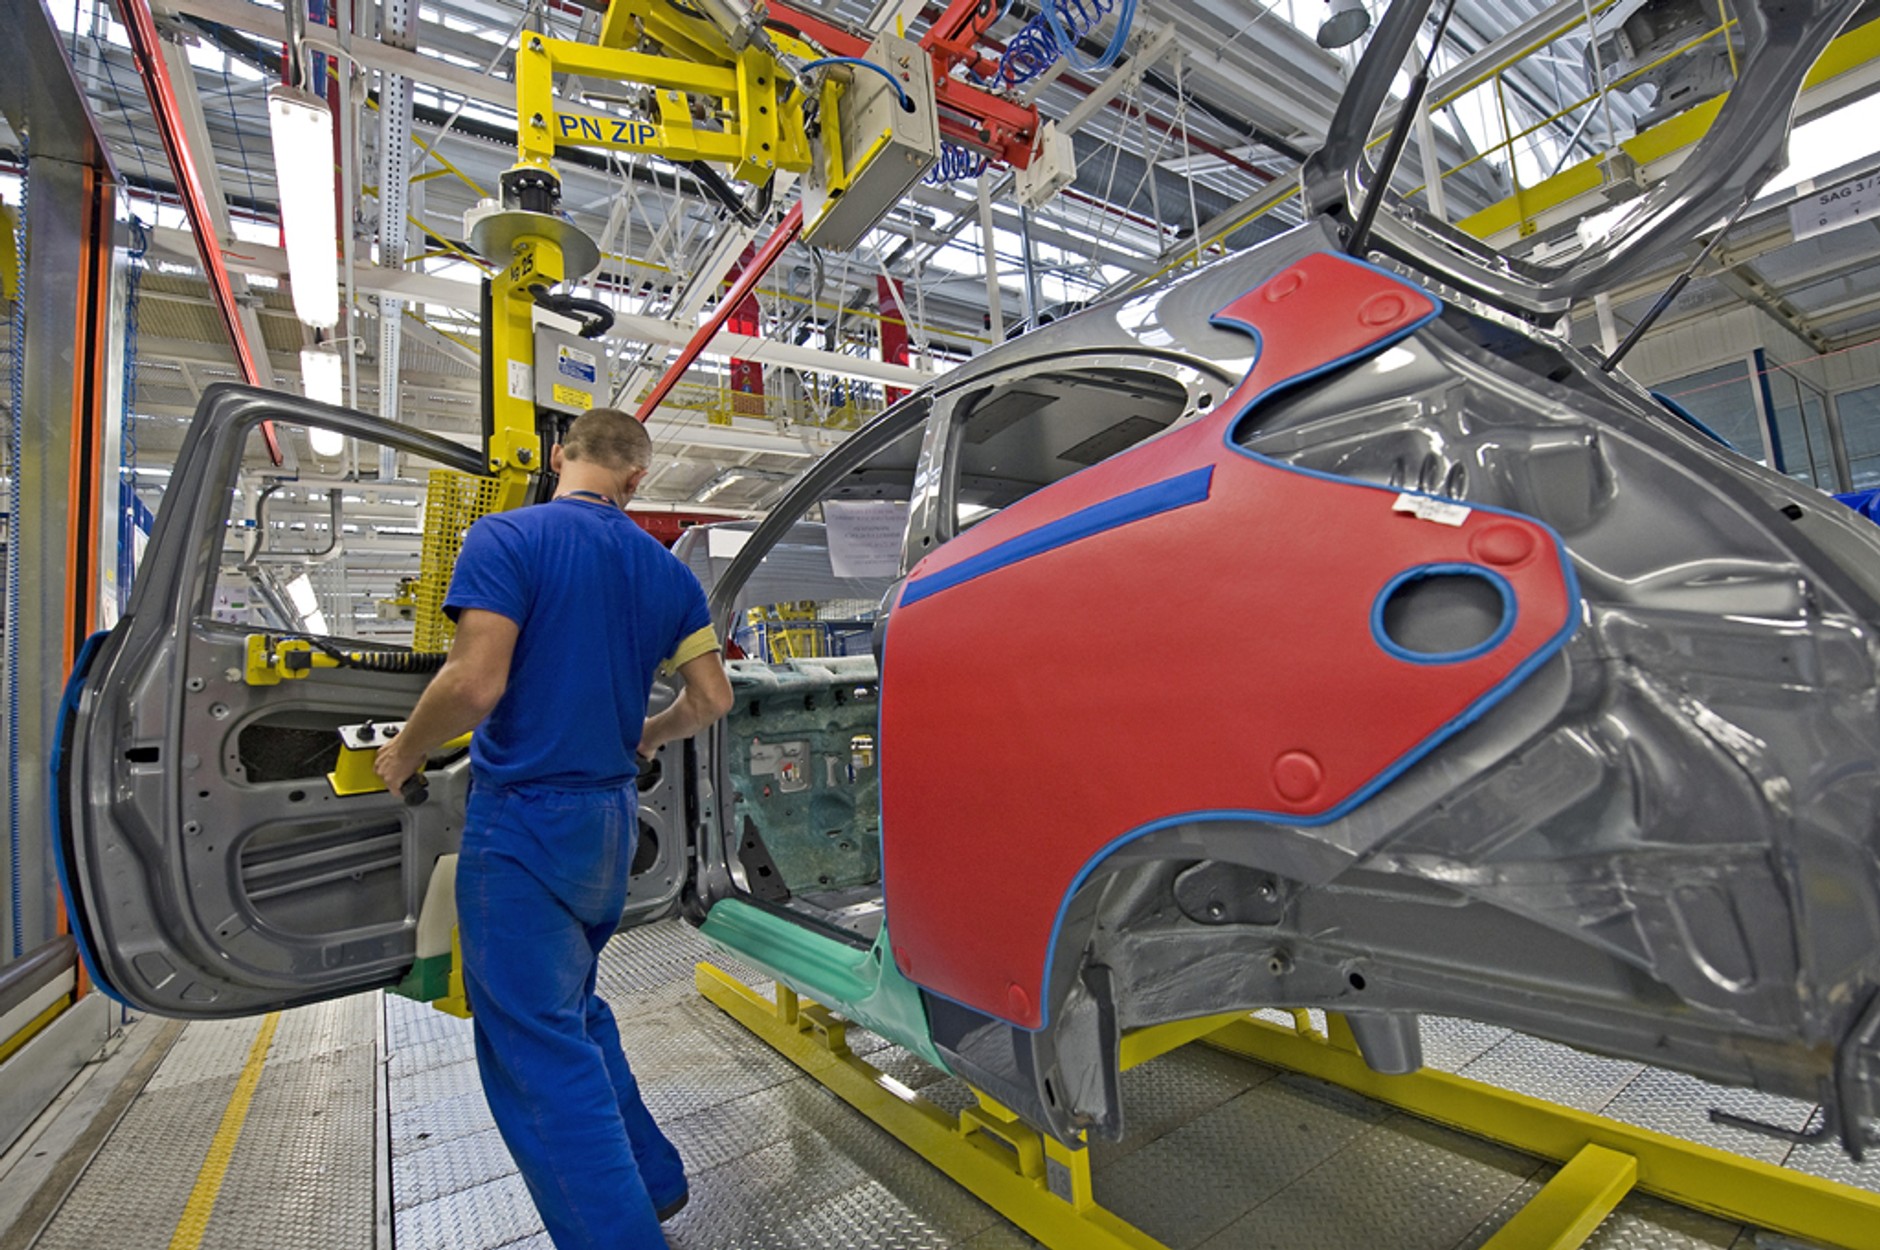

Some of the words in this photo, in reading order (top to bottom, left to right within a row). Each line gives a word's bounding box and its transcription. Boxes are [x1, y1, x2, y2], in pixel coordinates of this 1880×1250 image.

[559, 115, 603, 140] PN
[611, 121, 656, 145] ZIP
[1819, 187, 1852, 206] SAG
[521, 253, 533, 276] 25
